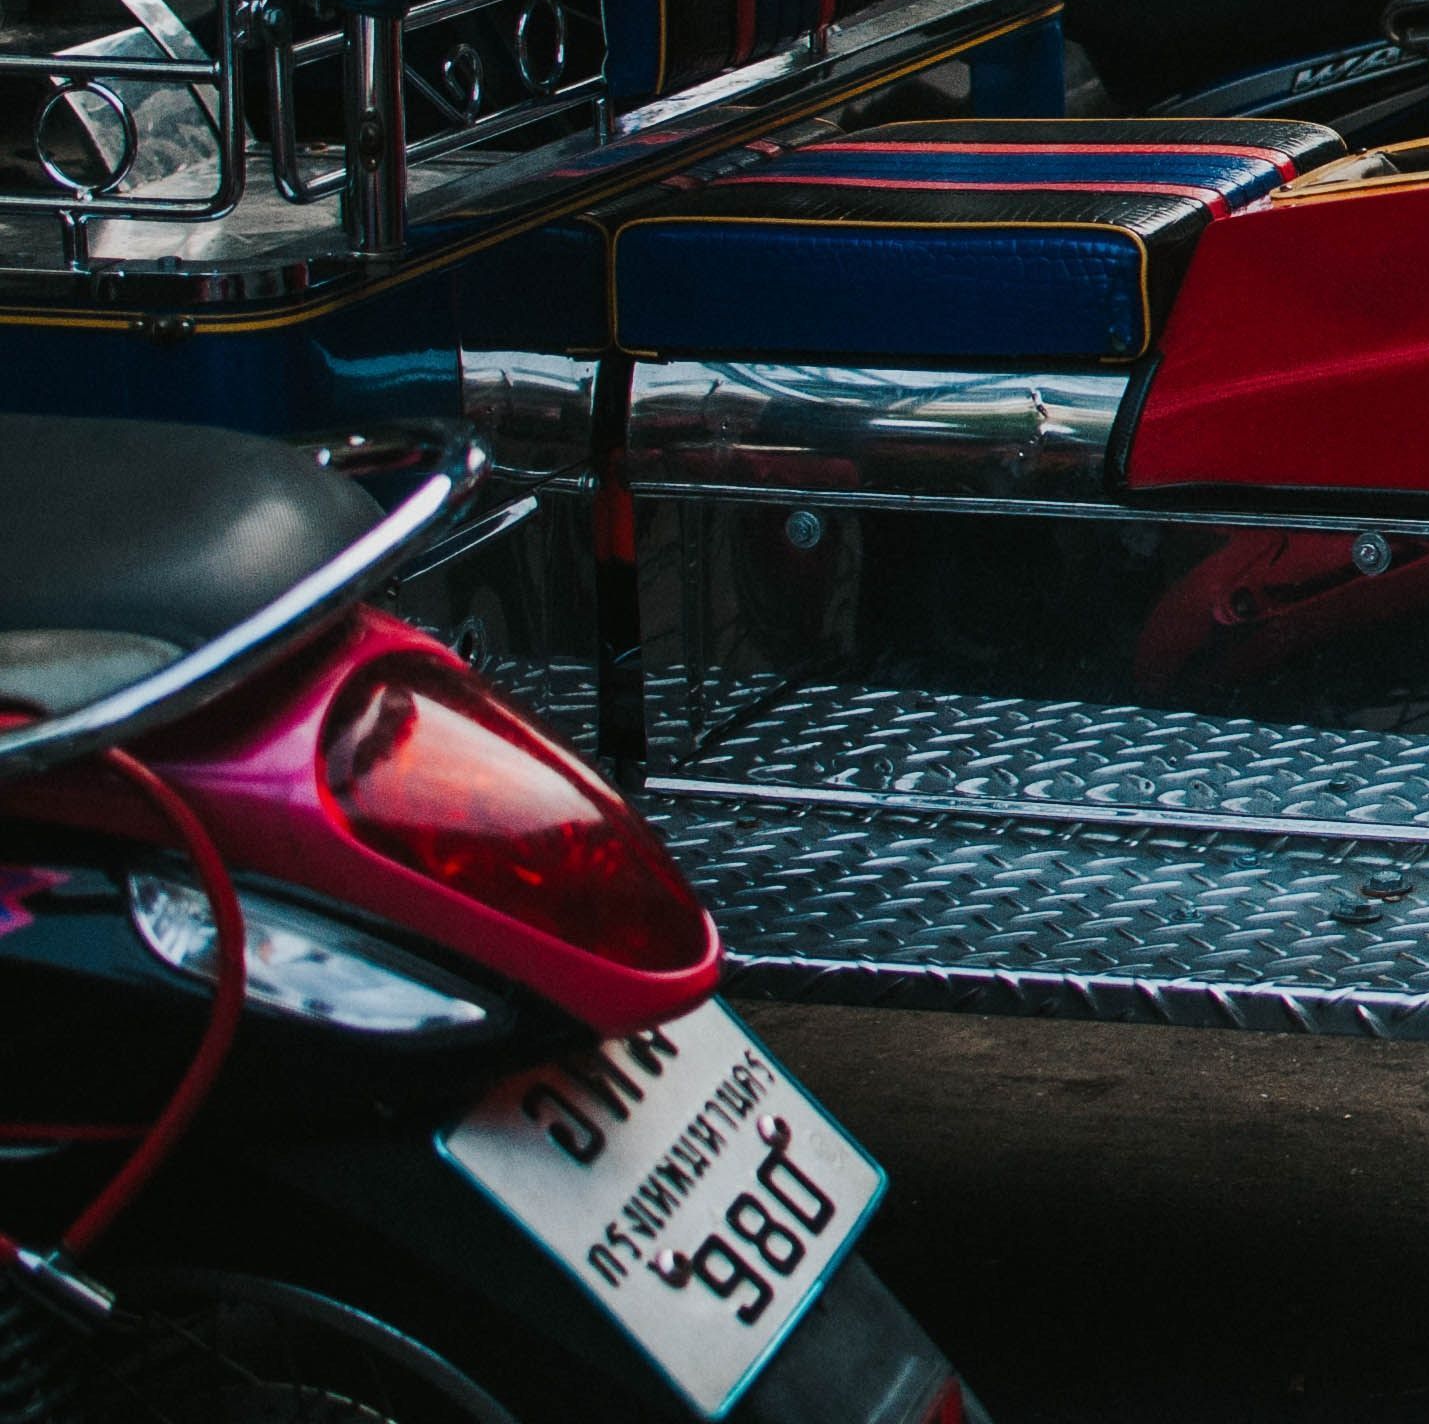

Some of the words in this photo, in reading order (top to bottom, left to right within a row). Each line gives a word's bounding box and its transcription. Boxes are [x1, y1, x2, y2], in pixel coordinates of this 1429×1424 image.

[587, 1049, 776, 1288] กรุงเทพมหานคร
[692, 1154, 836, 1326] 980
